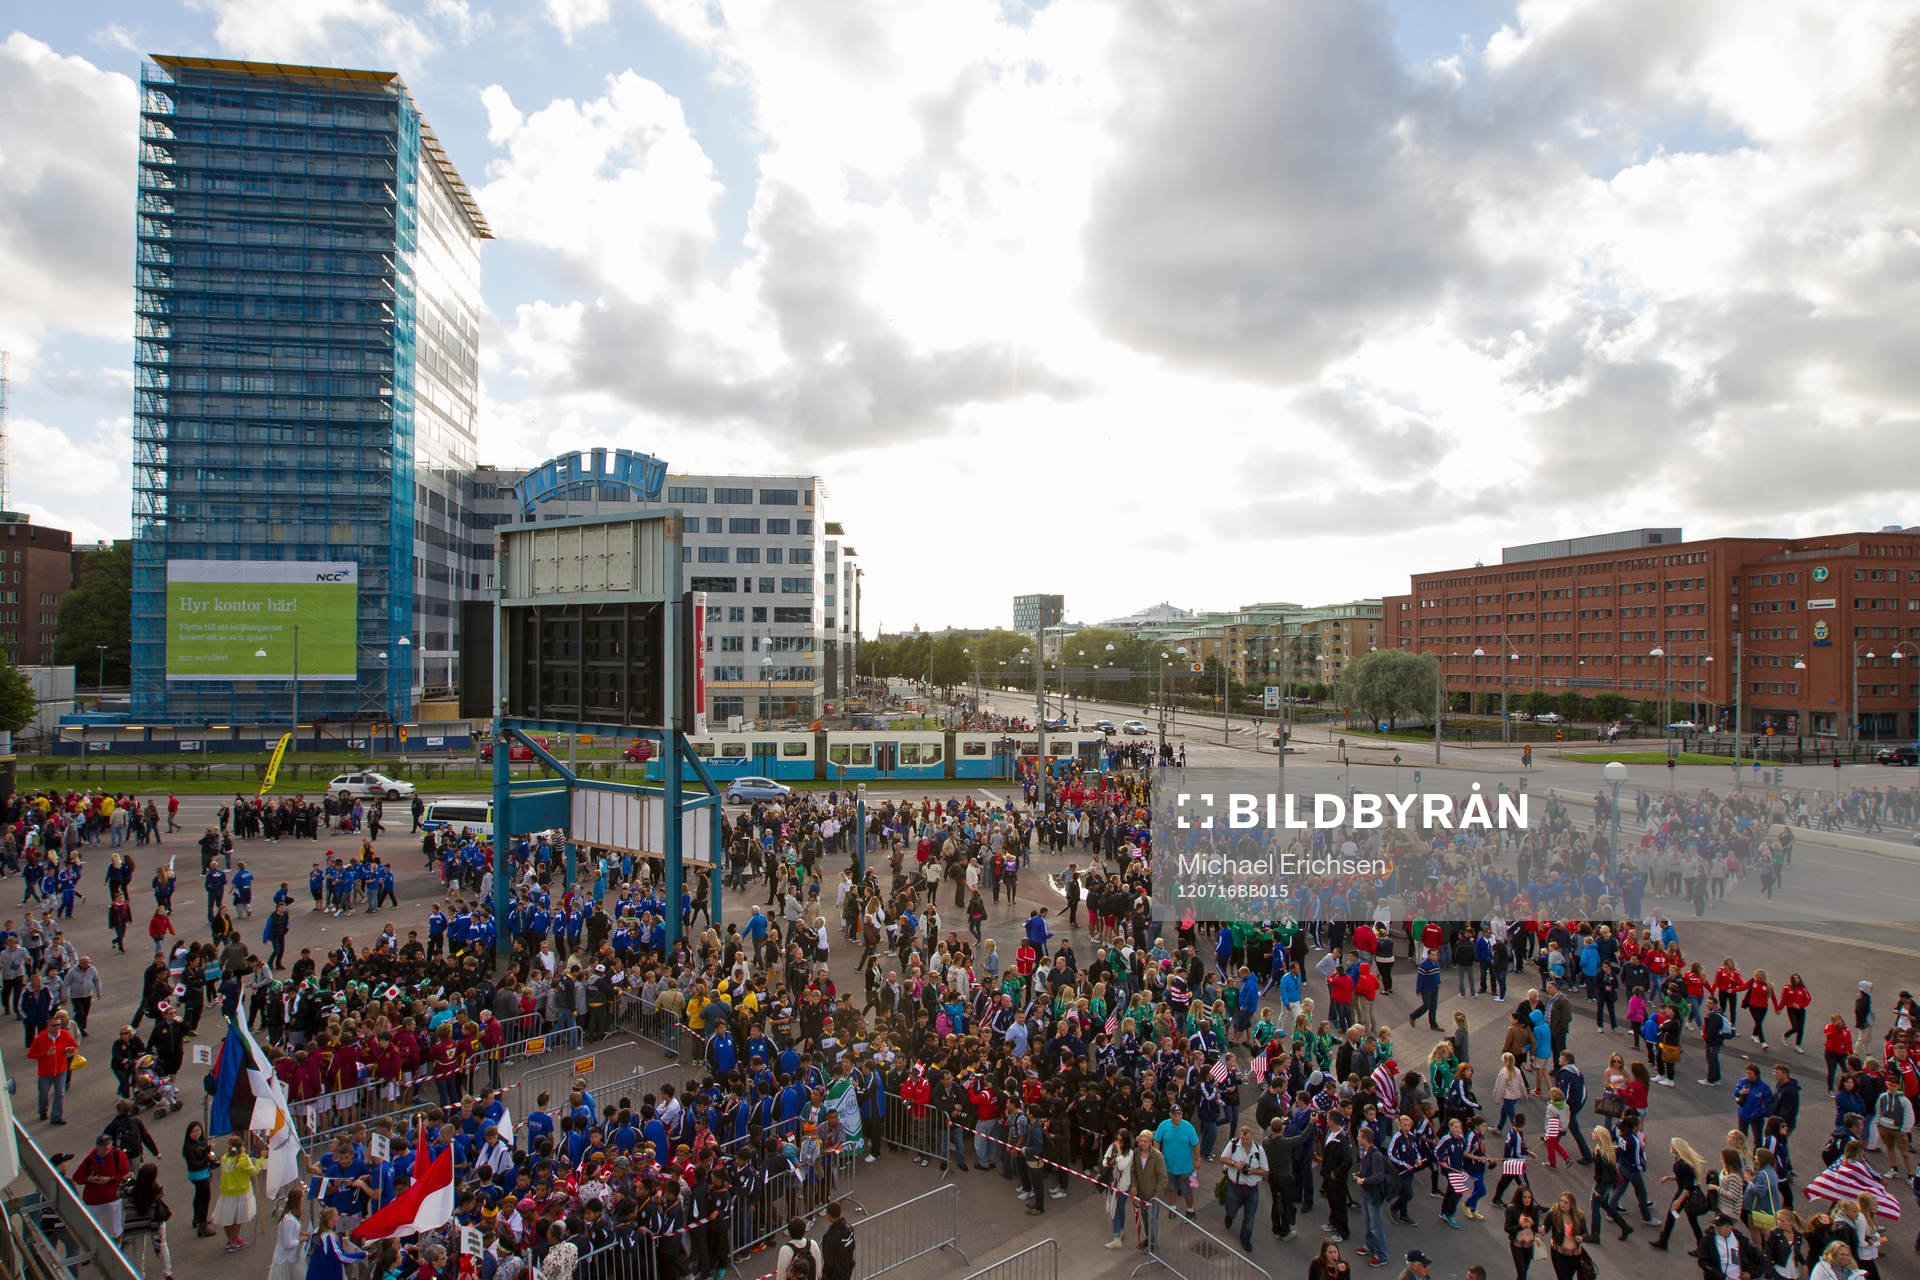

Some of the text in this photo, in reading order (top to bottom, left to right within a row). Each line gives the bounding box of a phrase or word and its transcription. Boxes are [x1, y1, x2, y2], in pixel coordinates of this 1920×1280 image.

[316, 573, 341, 582] NCC
[179, 597, 297, 613] Hyr kontor här!
